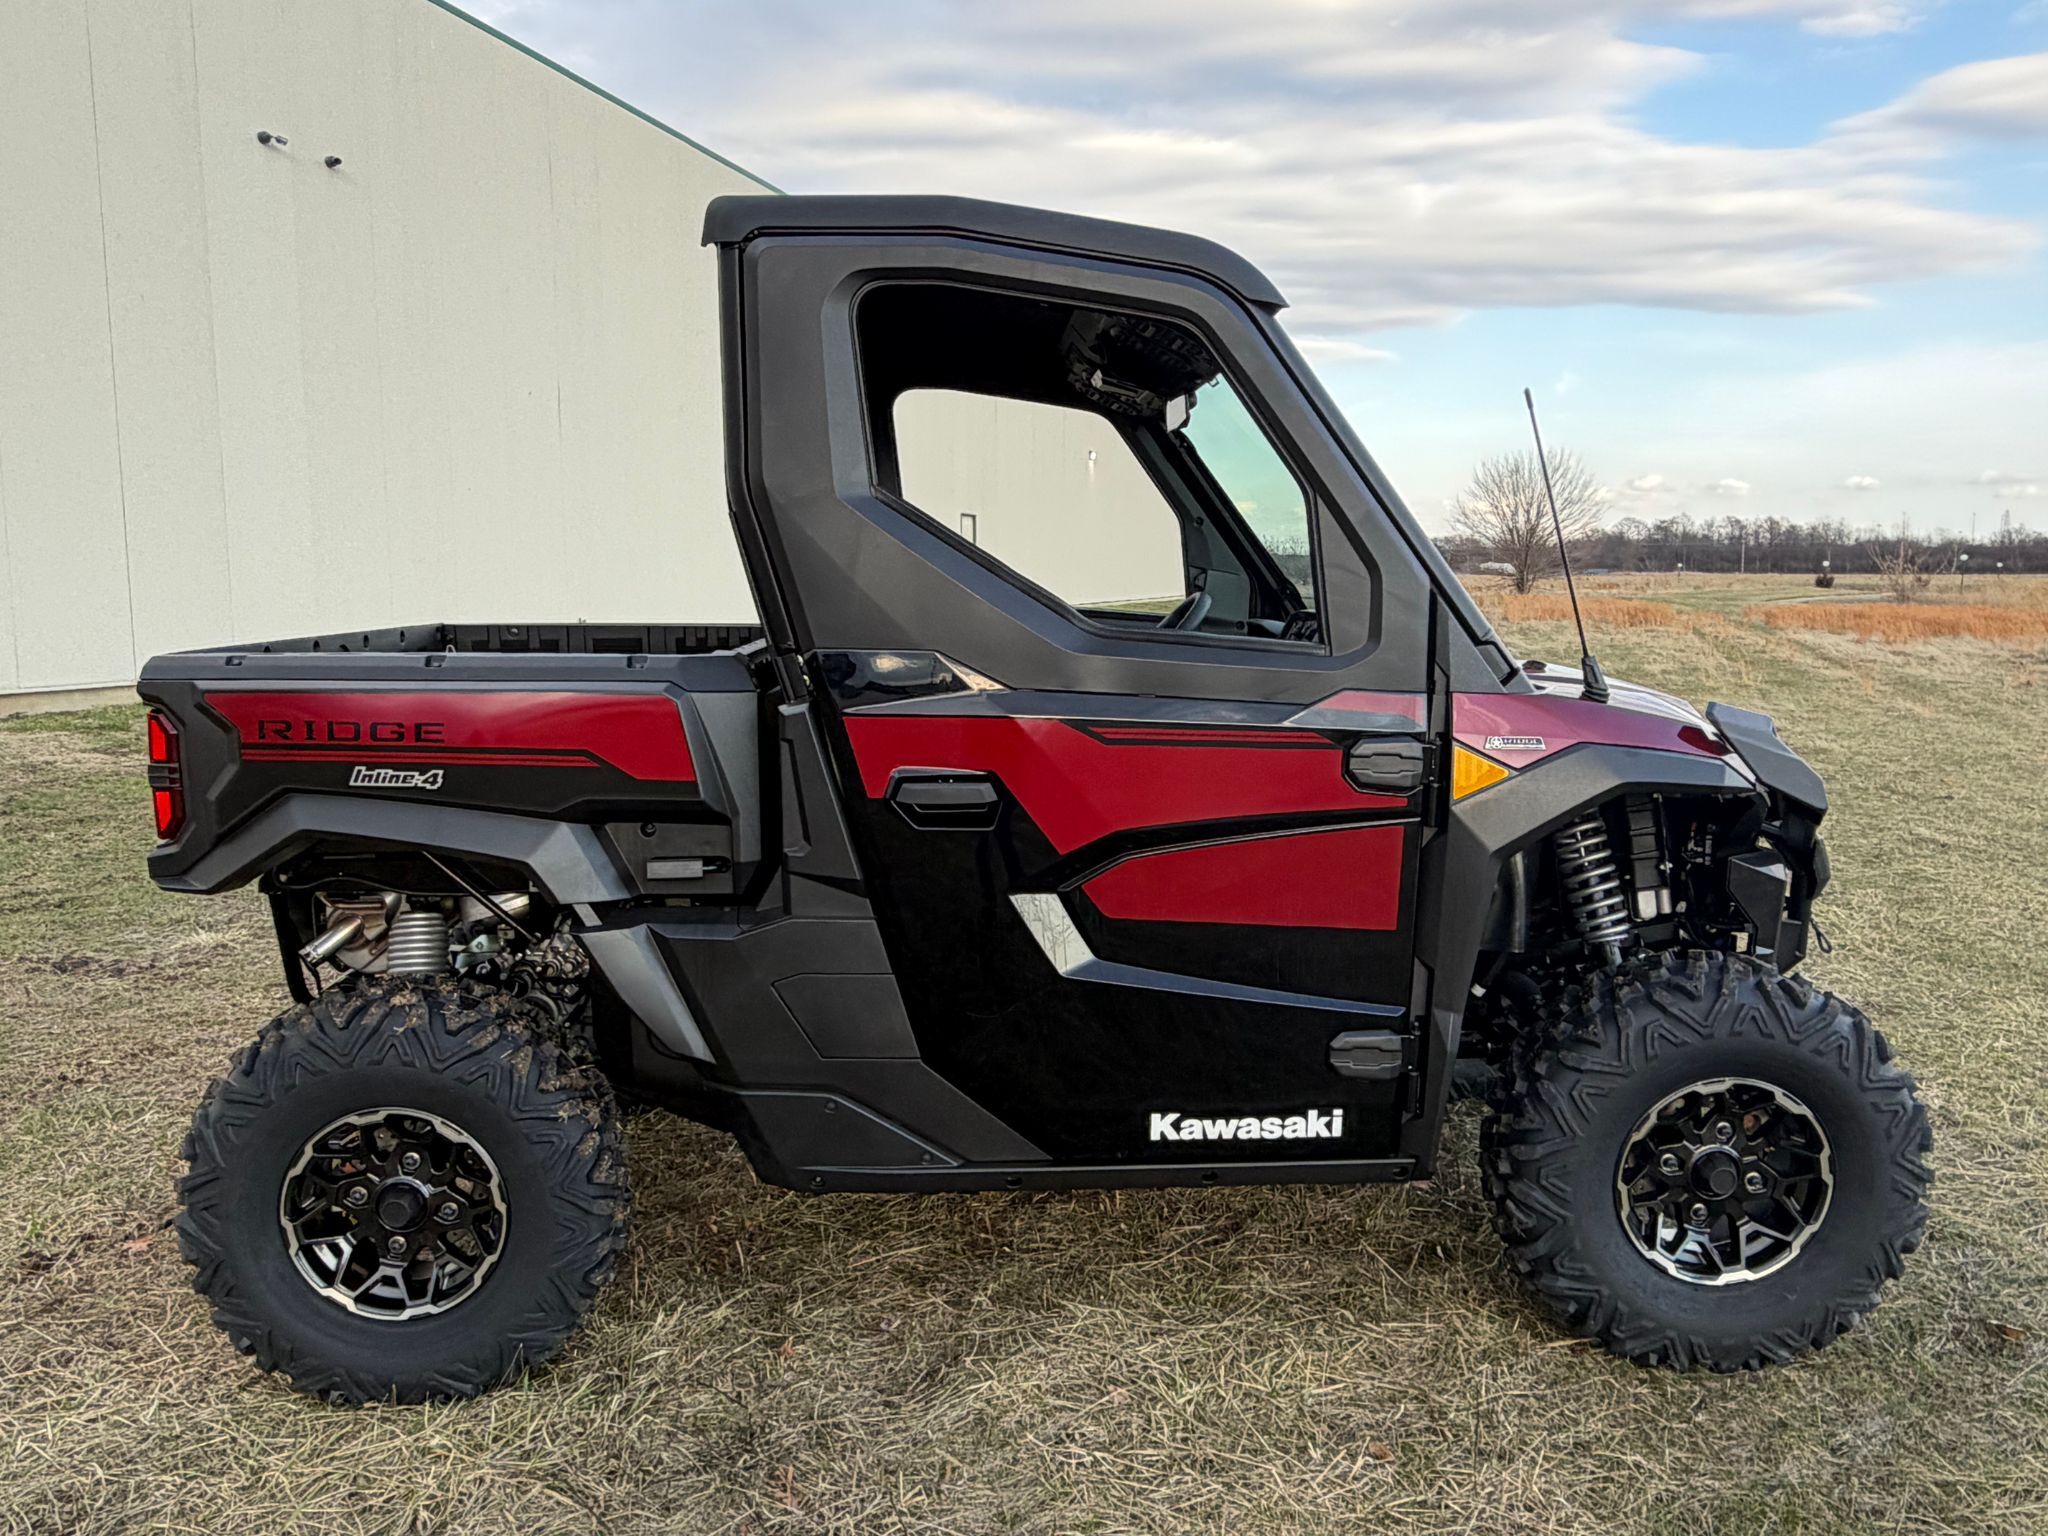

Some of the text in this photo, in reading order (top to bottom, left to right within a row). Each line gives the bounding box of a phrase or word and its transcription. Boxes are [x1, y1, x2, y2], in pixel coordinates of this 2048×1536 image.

[258, 720, 445, 743] RIDGE
[349, 766, 444, 790] Inline-4
[1150, 1109, 1344, 1141] Kawasaki
